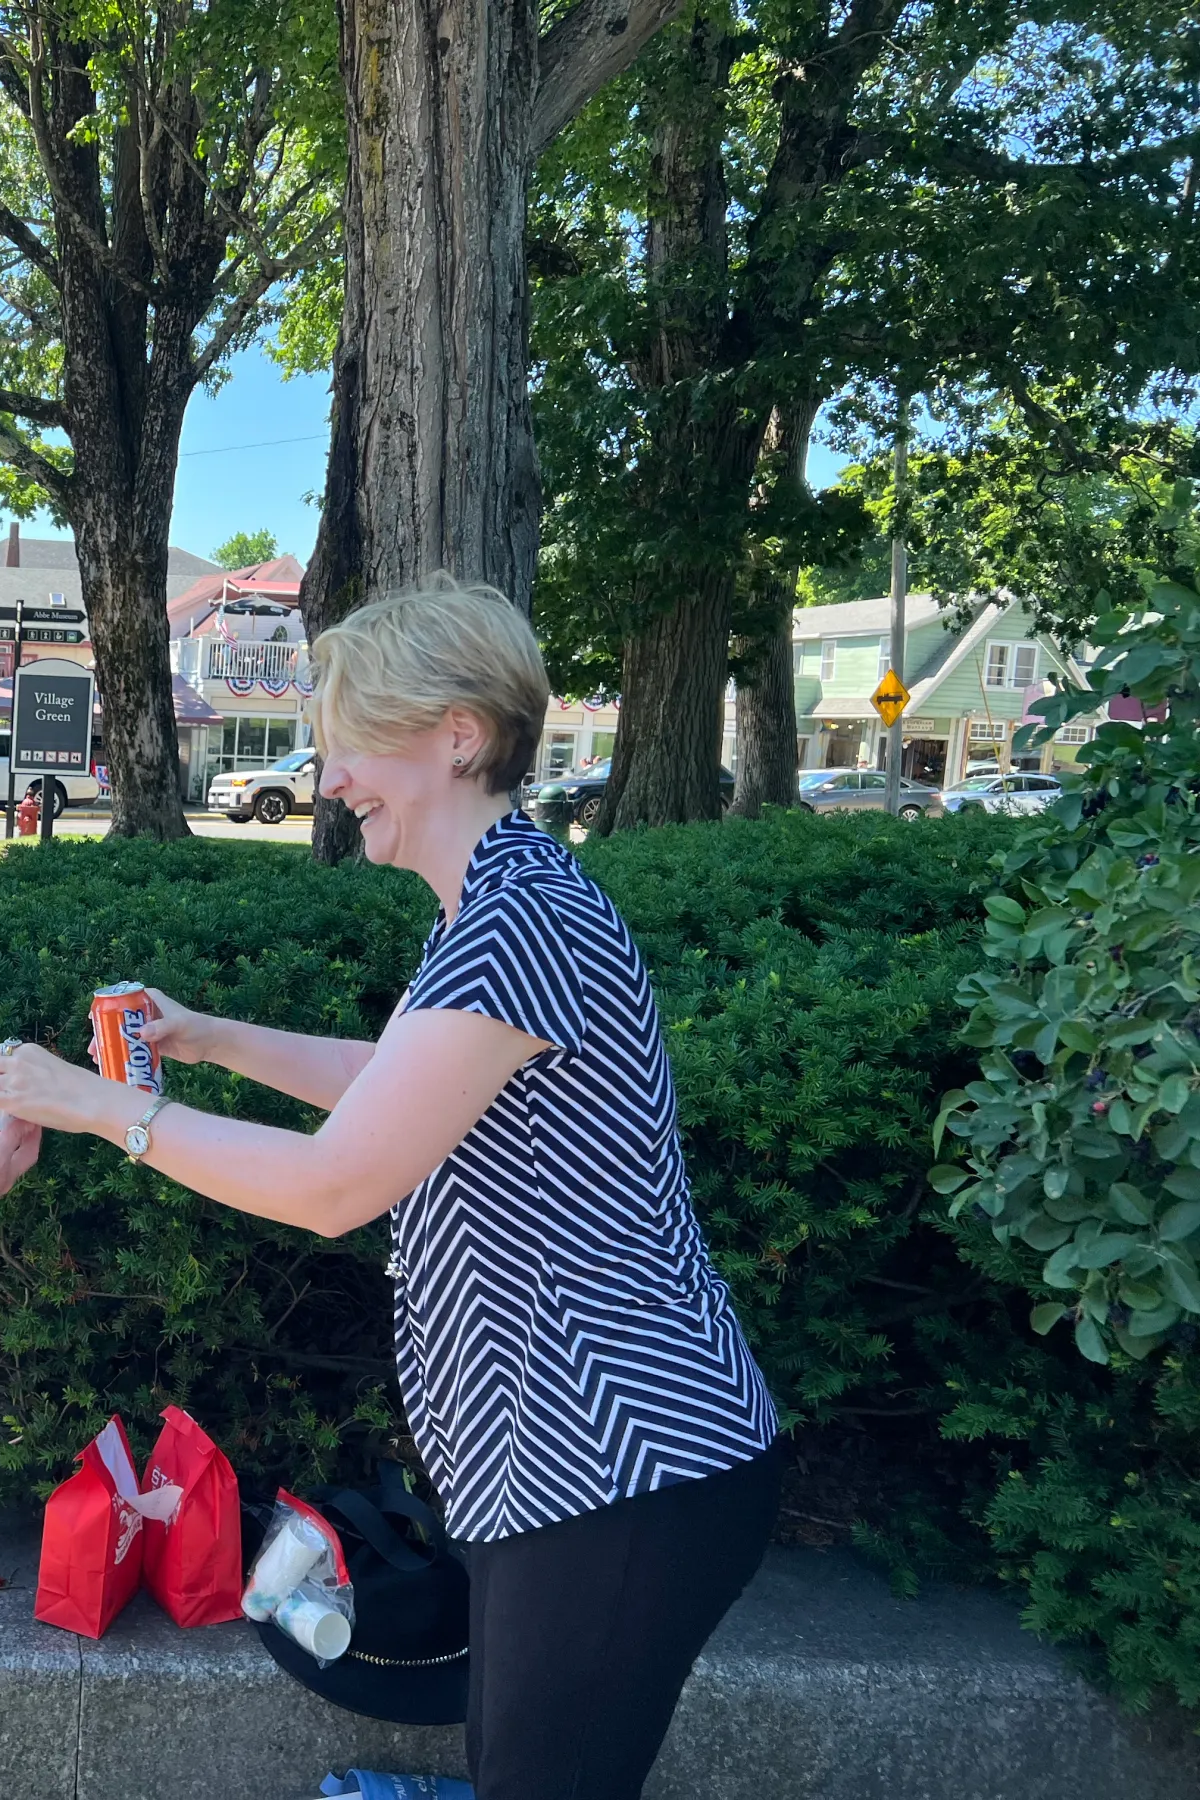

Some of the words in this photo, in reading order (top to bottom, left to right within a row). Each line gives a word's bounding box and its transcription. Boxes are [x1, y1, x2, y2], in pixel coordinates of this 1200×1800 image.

[33, 611, 50, 619] Abbe
[51, 612, 79, 620] Museum
[34, 692, 75, 708] Village
[35, 709, 71, 722] Green
